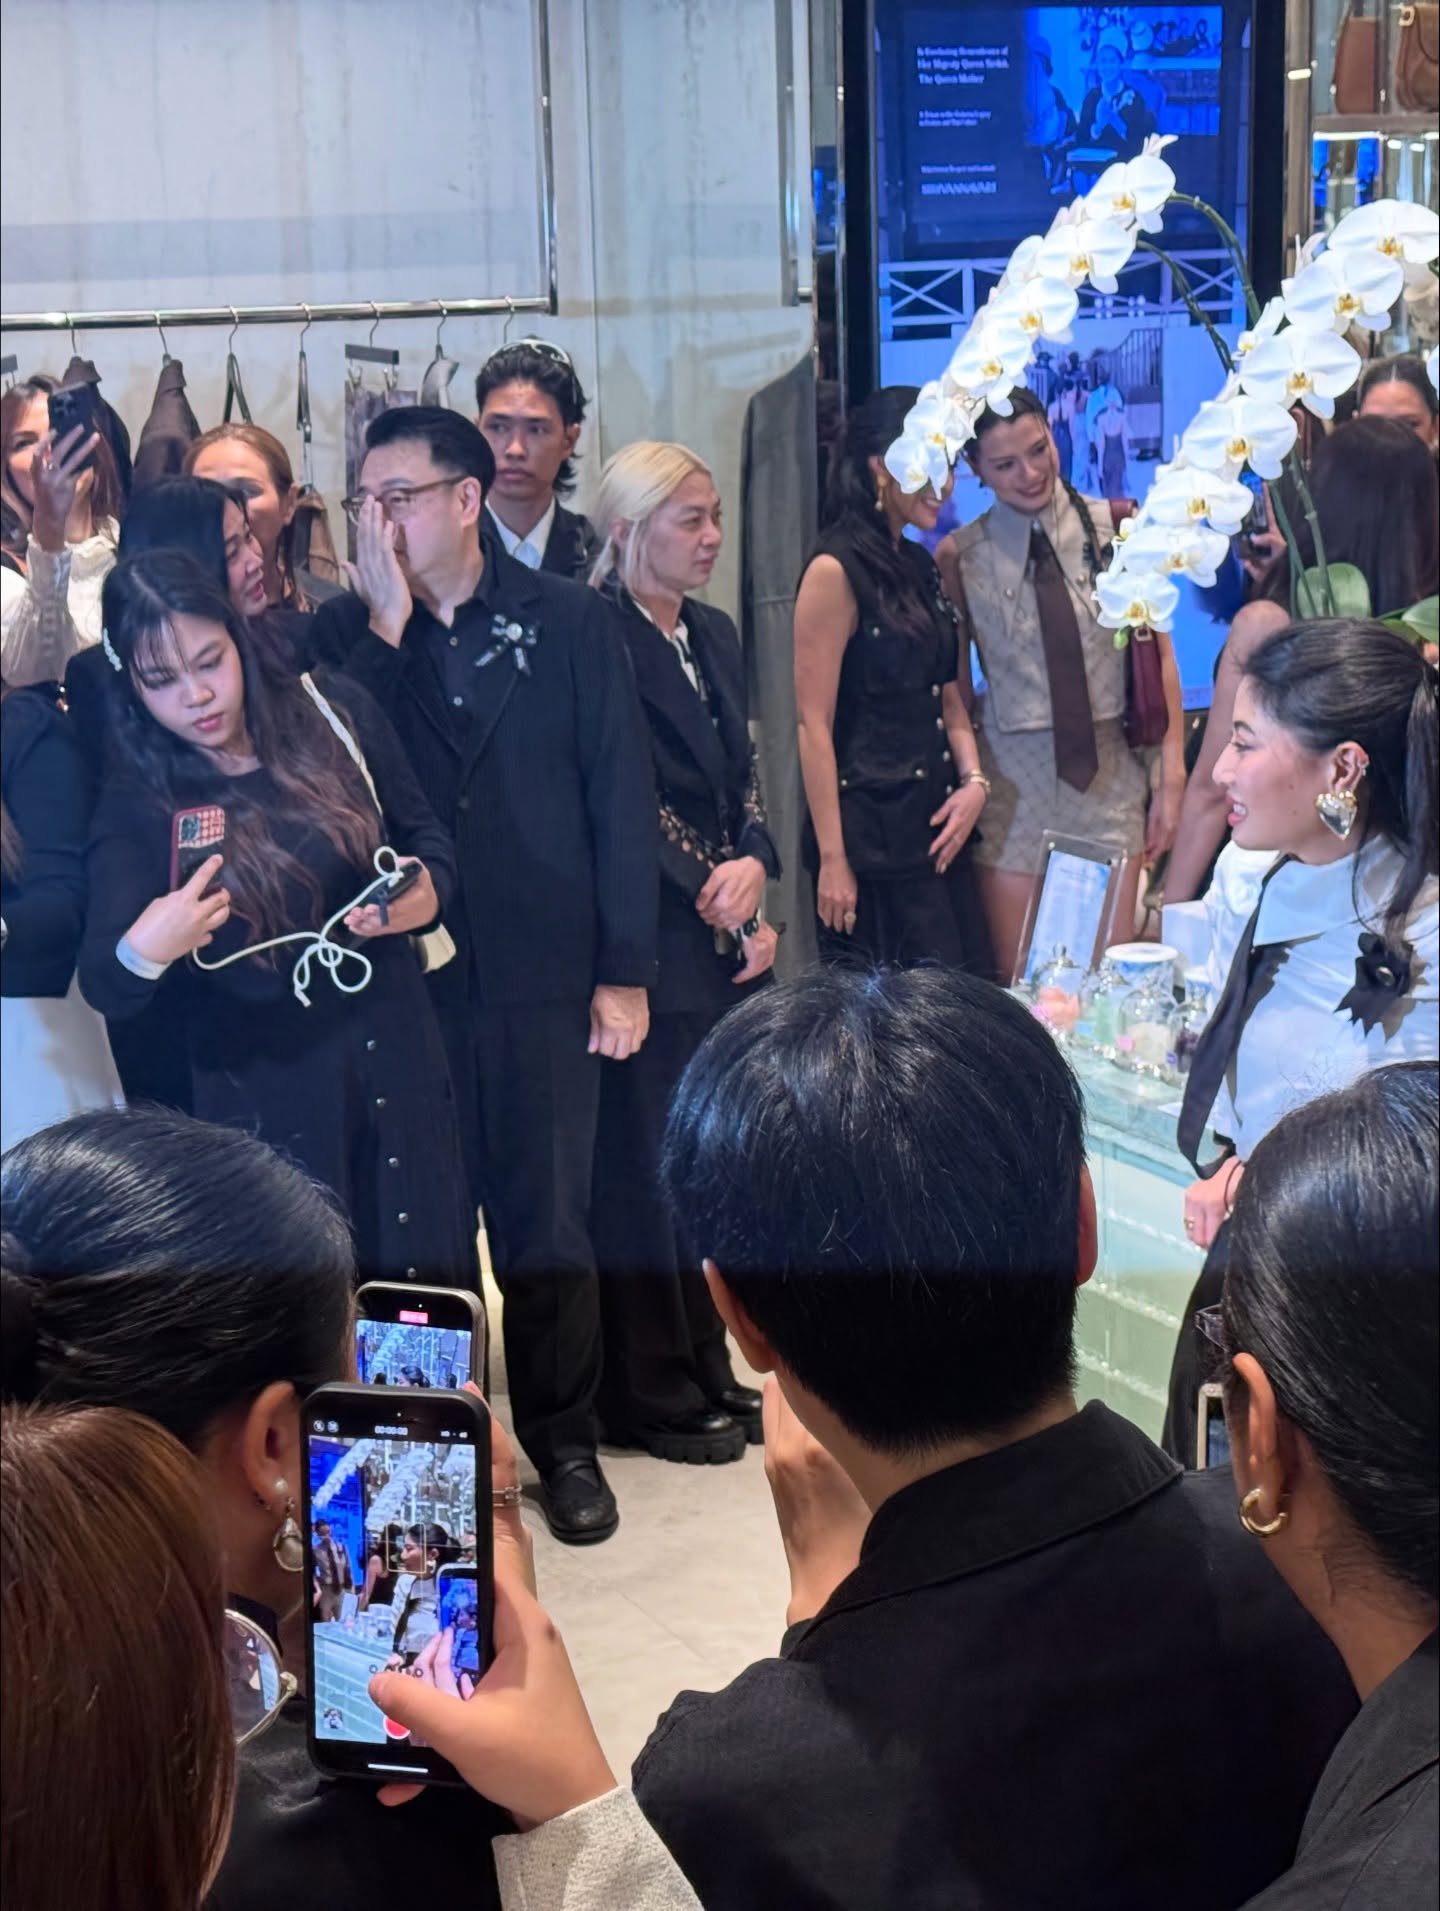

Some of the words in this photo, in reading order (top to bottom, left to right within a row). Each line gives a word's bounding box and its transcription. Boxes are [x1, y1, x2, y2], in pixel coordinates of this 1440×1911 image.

[917, 58, 931, 69] Her
[932, 58, 960, 70] Majesty
[961, 58, 984, 70] Queen
[919, 73, 933, 84] The
[934, 73, 957, 85] Queen
[958, 73, 984, 84] Mother
